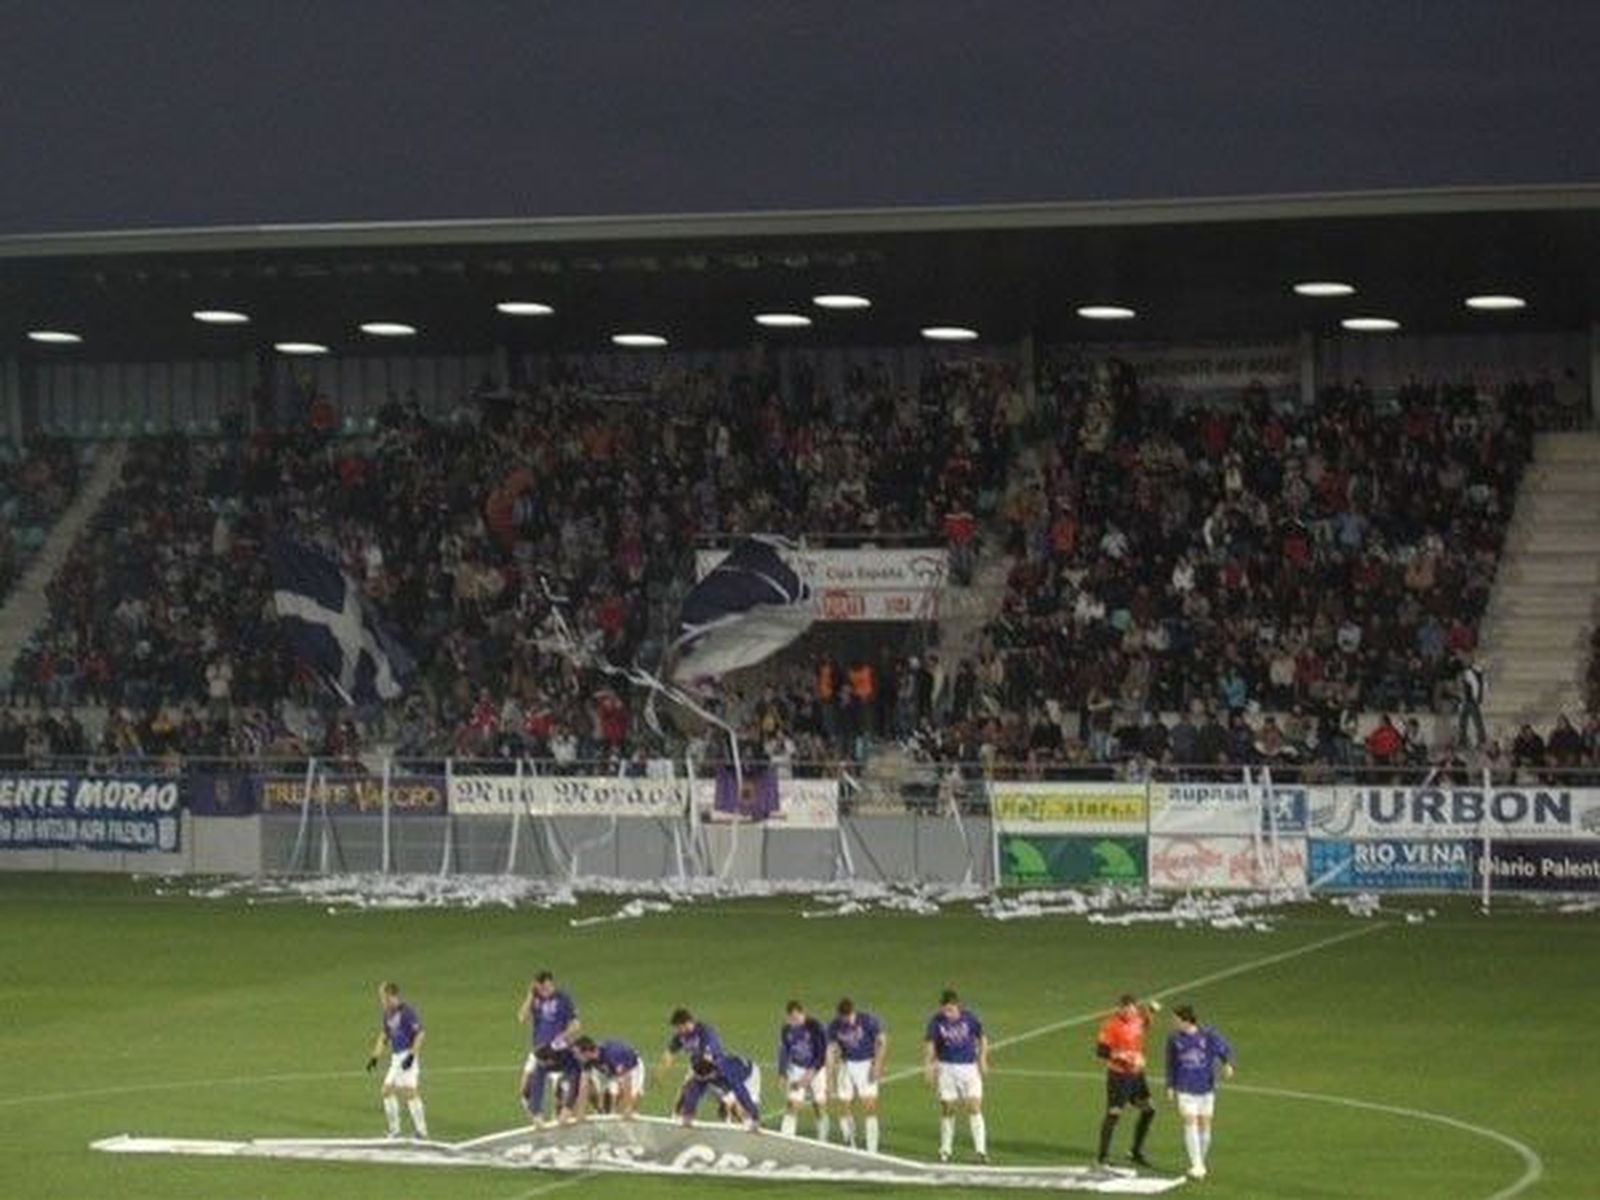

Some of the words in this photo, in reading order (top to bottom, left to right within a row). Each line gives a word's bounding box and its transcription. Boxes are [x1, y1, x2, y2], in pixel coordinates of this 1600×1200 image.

[74, 779, 177, 811] MORAO
[1368, 791, 1571, 824] URBON
[1478, 856, 1535, 877] Diario
